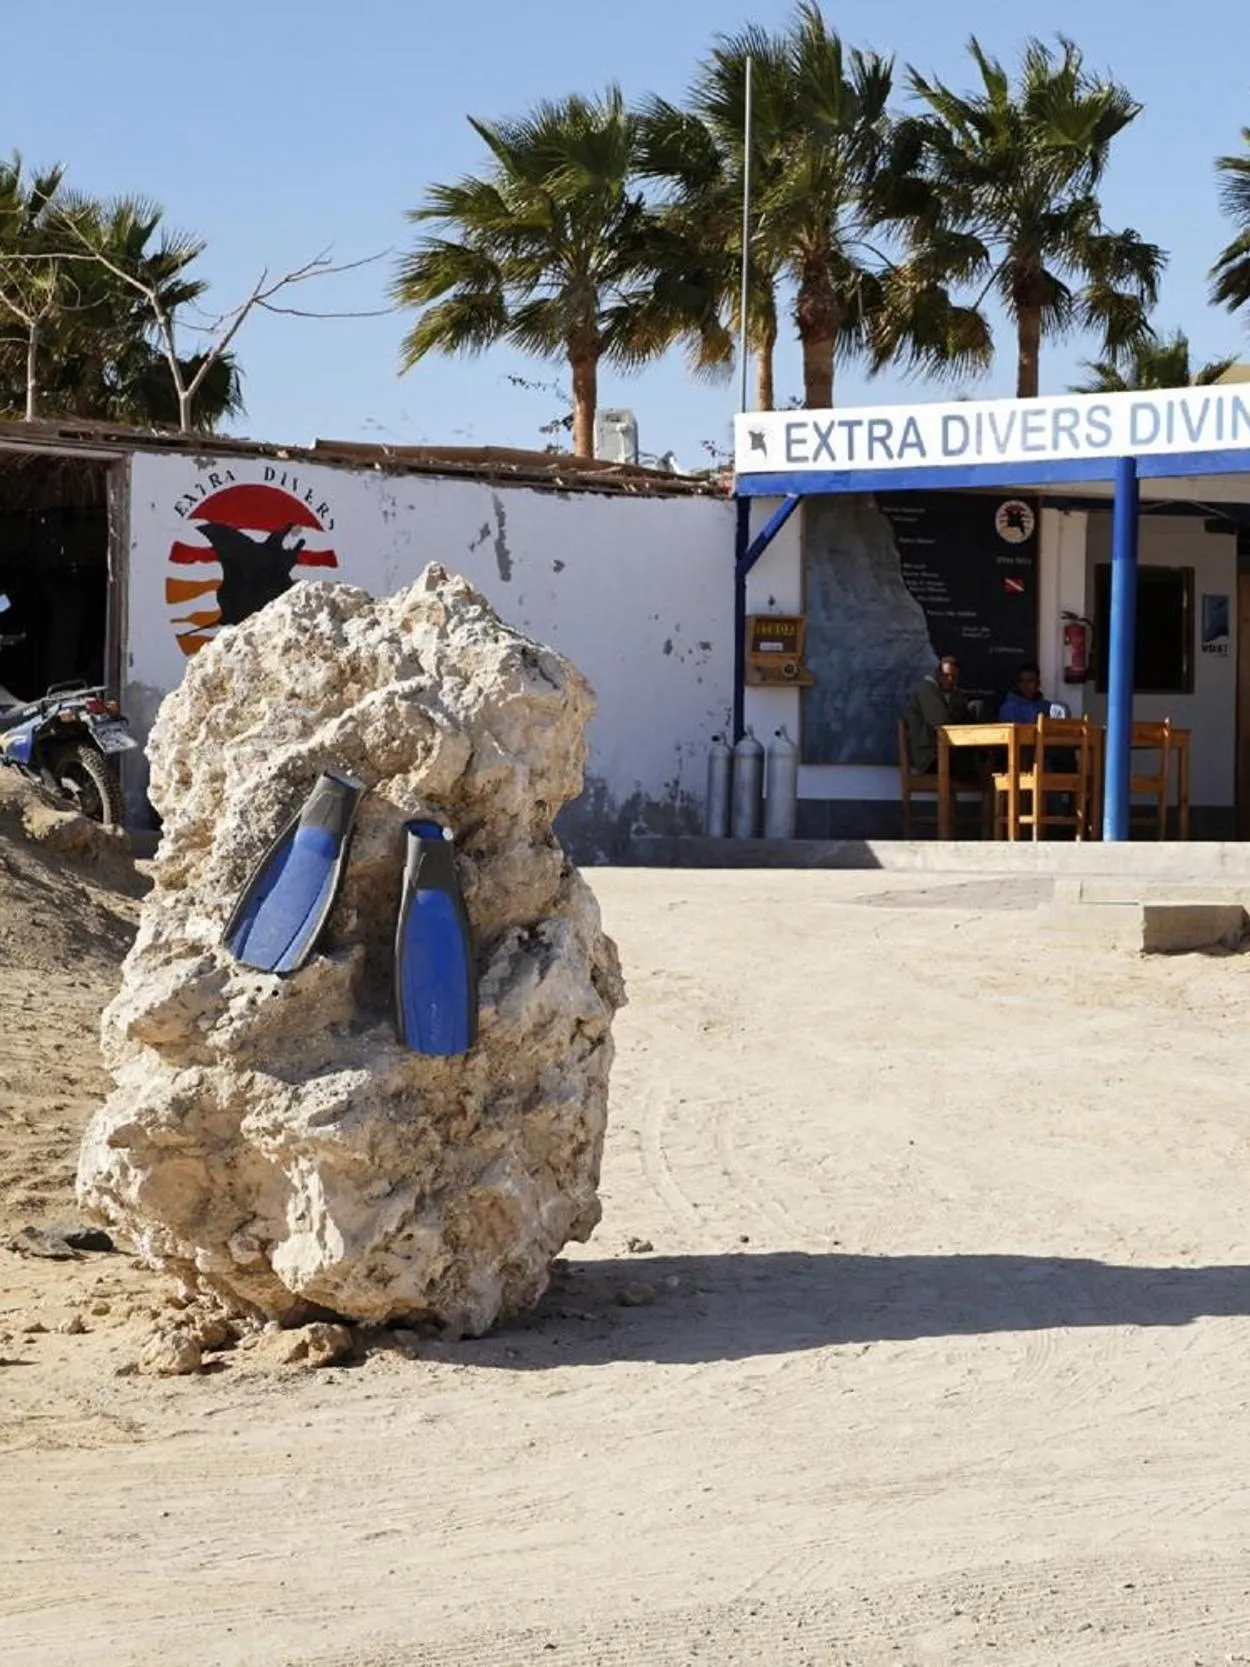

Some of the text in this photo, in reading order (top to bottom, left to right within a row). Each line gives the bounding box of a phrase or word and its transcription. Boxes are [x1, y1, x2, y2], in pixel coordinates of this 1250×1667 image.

[786, 416, 926, 463] EXTRA
[942, 405, 1112, 456] DIVERS
[174, 470, 235, 517] EXTRA
